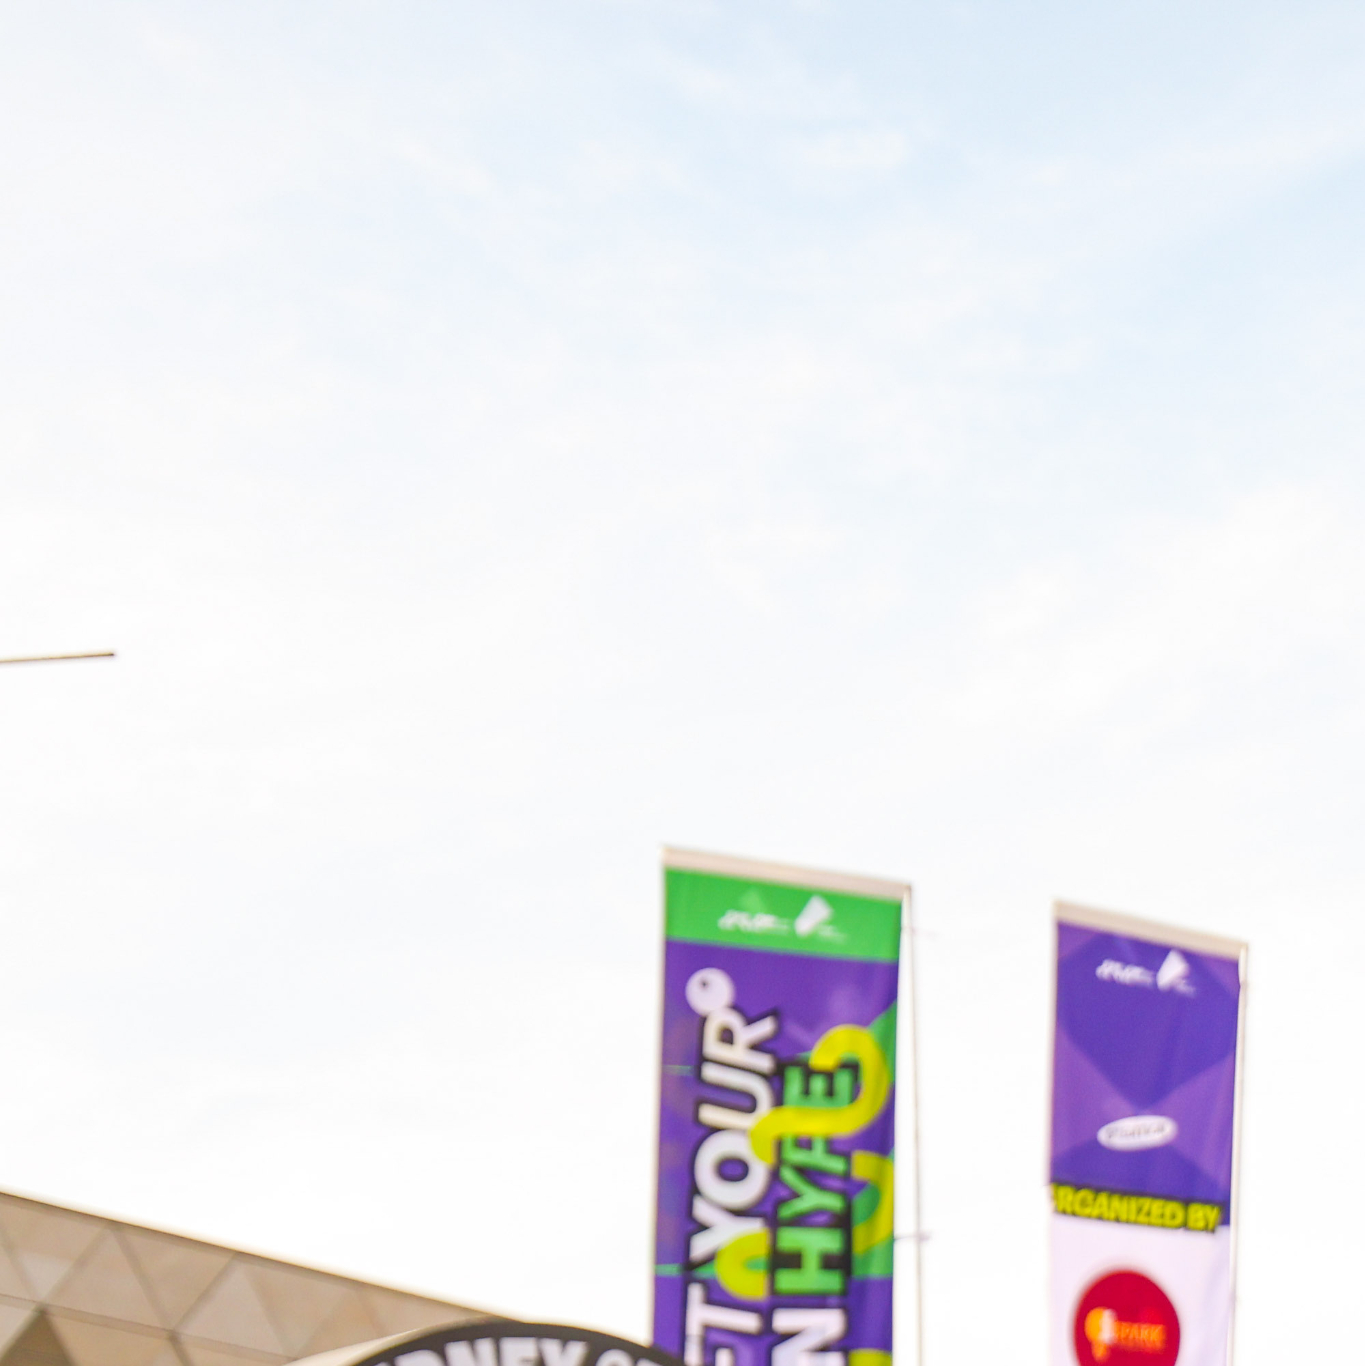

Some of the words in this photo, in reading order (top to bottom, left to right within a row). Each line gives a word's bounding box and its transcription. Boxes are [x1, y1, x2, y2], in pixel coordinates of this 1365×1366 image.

[689, 1006, 778, 1262] YOUR
[1052, 1182, 1187, 1230] RGANIZED
[1186, 1202, 1221, 1233] BY
